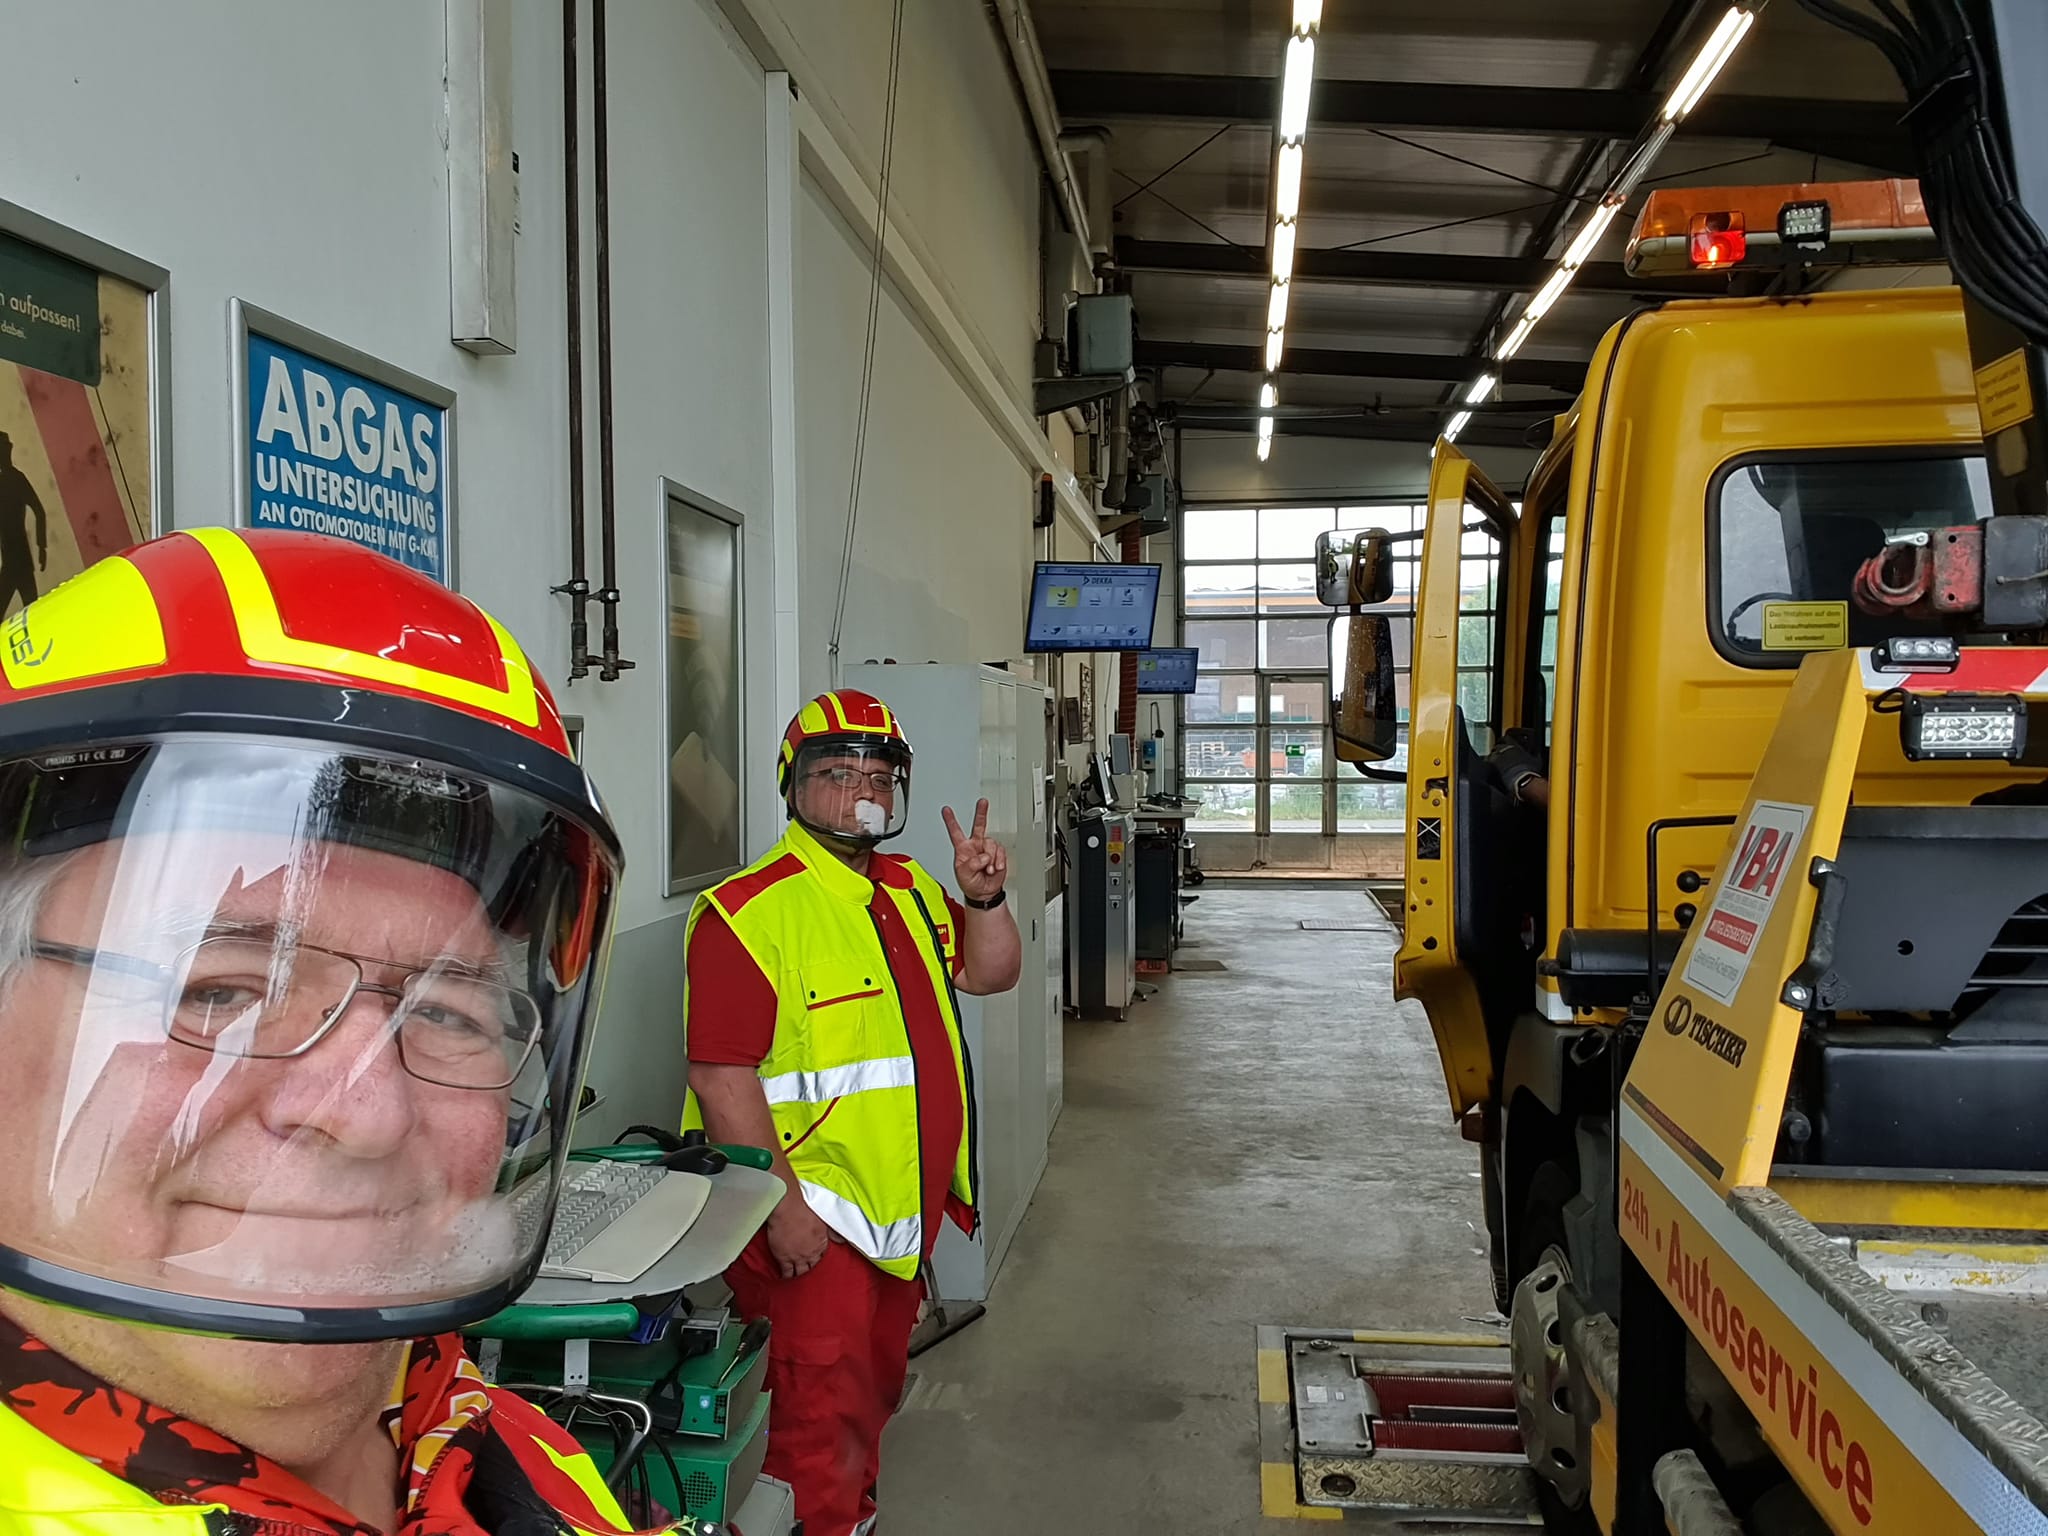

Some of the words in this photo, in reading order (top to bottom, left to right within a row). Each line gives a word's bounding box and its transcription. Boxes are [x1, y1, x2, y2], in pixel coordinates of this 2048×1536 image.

[10, 294, 81, 333] aufpassen!
[256, 355, 437, 494] ABGAS
[256, 452, 436, 534] UNTERSUCHUNG
[259, 500, 285, 524] AN
[289, 506, 386, 546] OTTOMOTOREN
[388, 530, 407, 550] MIT
[1729, 825, 1794, 896] VBA
[1688, 1012, 1747, 1069] TISCHER
[1623, 1177, 1650, 1241] 24h
[1666, 1221, 1874, 1527] Autoservice
